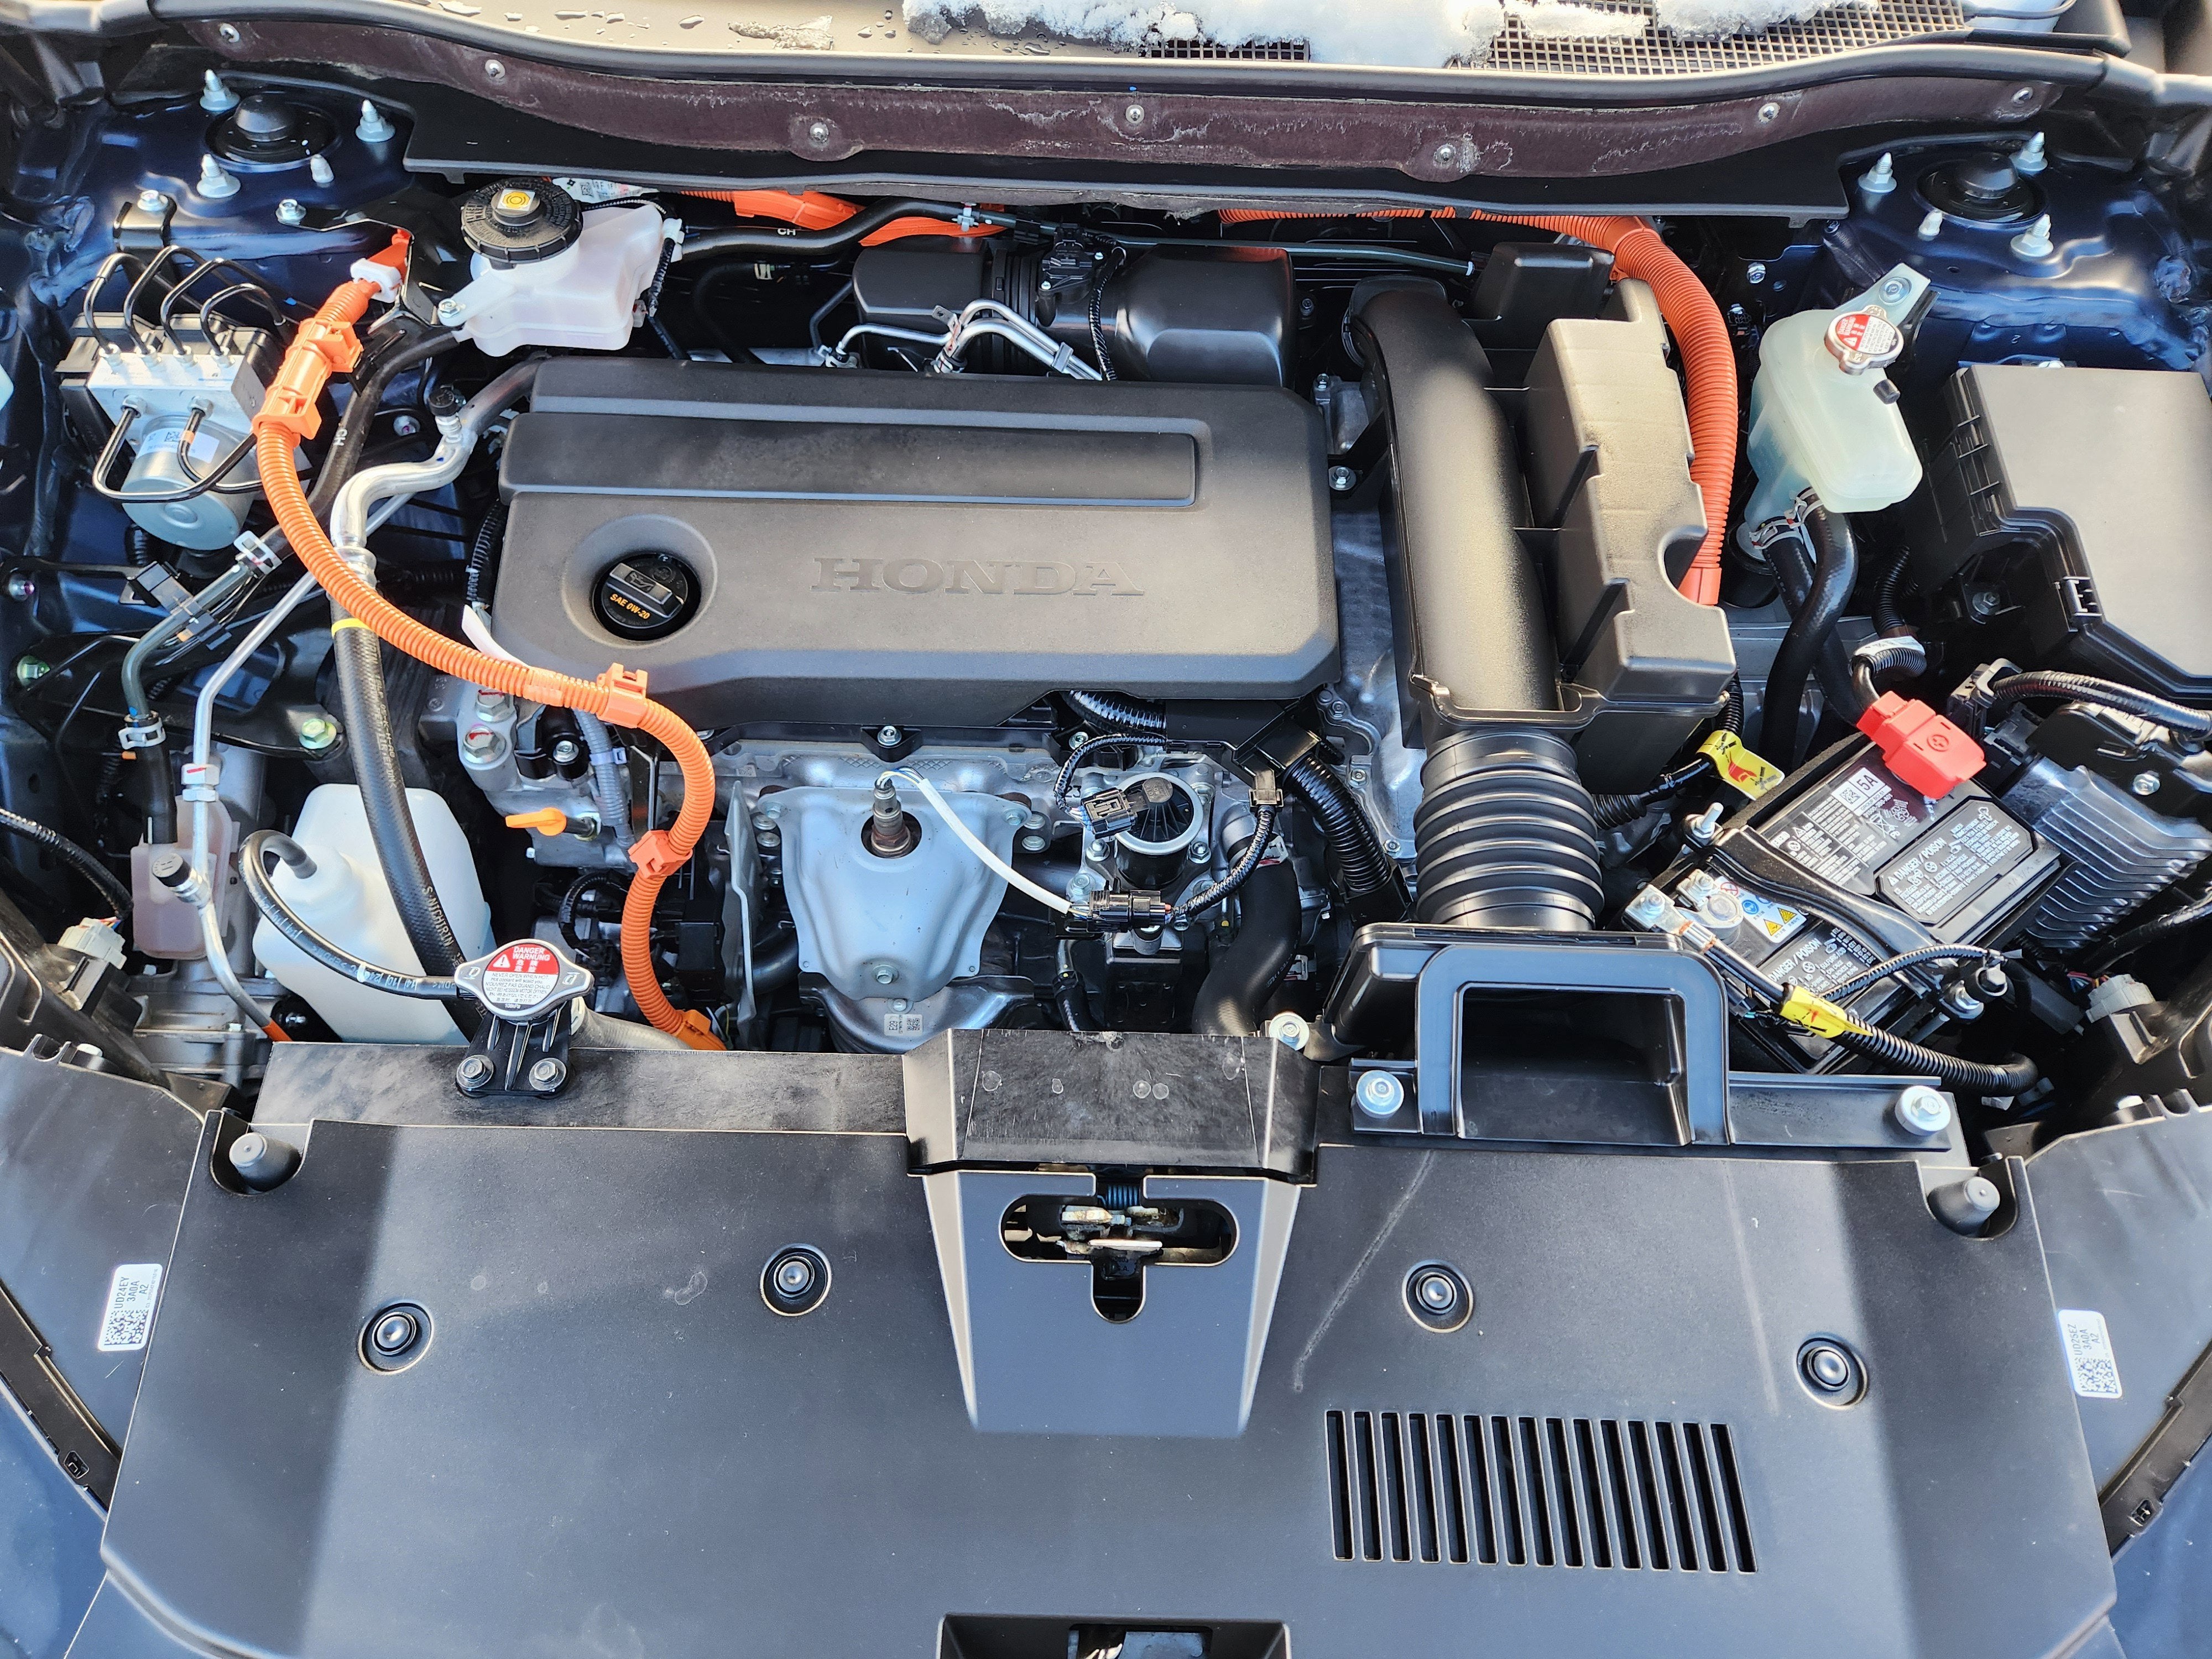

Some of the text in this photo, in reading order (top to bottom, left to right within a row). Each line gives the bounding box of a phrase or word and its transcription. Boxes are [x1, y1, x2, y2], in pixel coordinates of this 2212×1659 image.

[333, 429, 348, 446] CH
[810, 556, 1145, 597] HONDA
[609, 594, 650, 619] SAE 0W-20
[1855, 773, 1878, 791] 5A
[1892, 857, 1923, 880] DANGER
[1919, 836, 1948, 859] POISON
[513, 953, 550, 961] WARNUNG
[1766, 958, 1797, 982] DANGER
[1793, 936, 1824, 961] POISON
[889, 1020, 898, 1030] E29
[114, 1277, 129, 1308] UD24EY
[139, 1284, 149, 1294] A2
[2068, 1324, 2083, 1355] UD25EZ
[2090, 1333, 2100, 1344] A2
